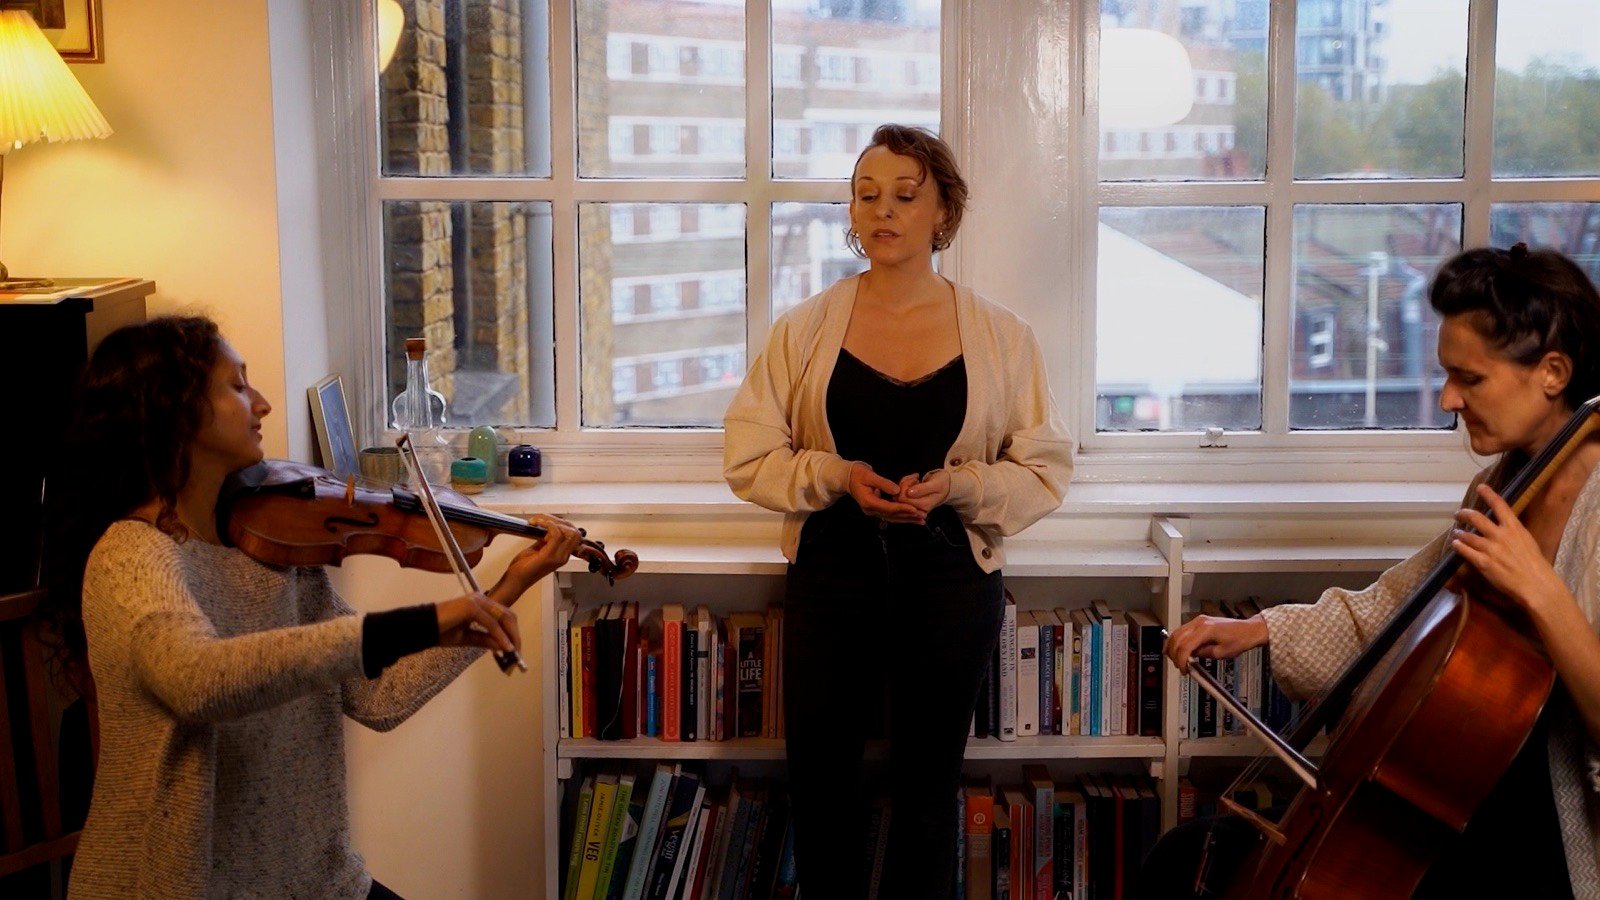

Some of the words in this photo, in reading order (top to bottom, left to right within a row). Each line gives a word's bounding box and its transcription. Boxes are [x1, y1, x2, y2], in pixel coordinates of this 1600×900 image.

[747, 651, 754, 659] A
[740, 660, 762, 668] LITTLE
[740, 668, 762, 681] LIFE
[586, 841, 600, 862] VEG
